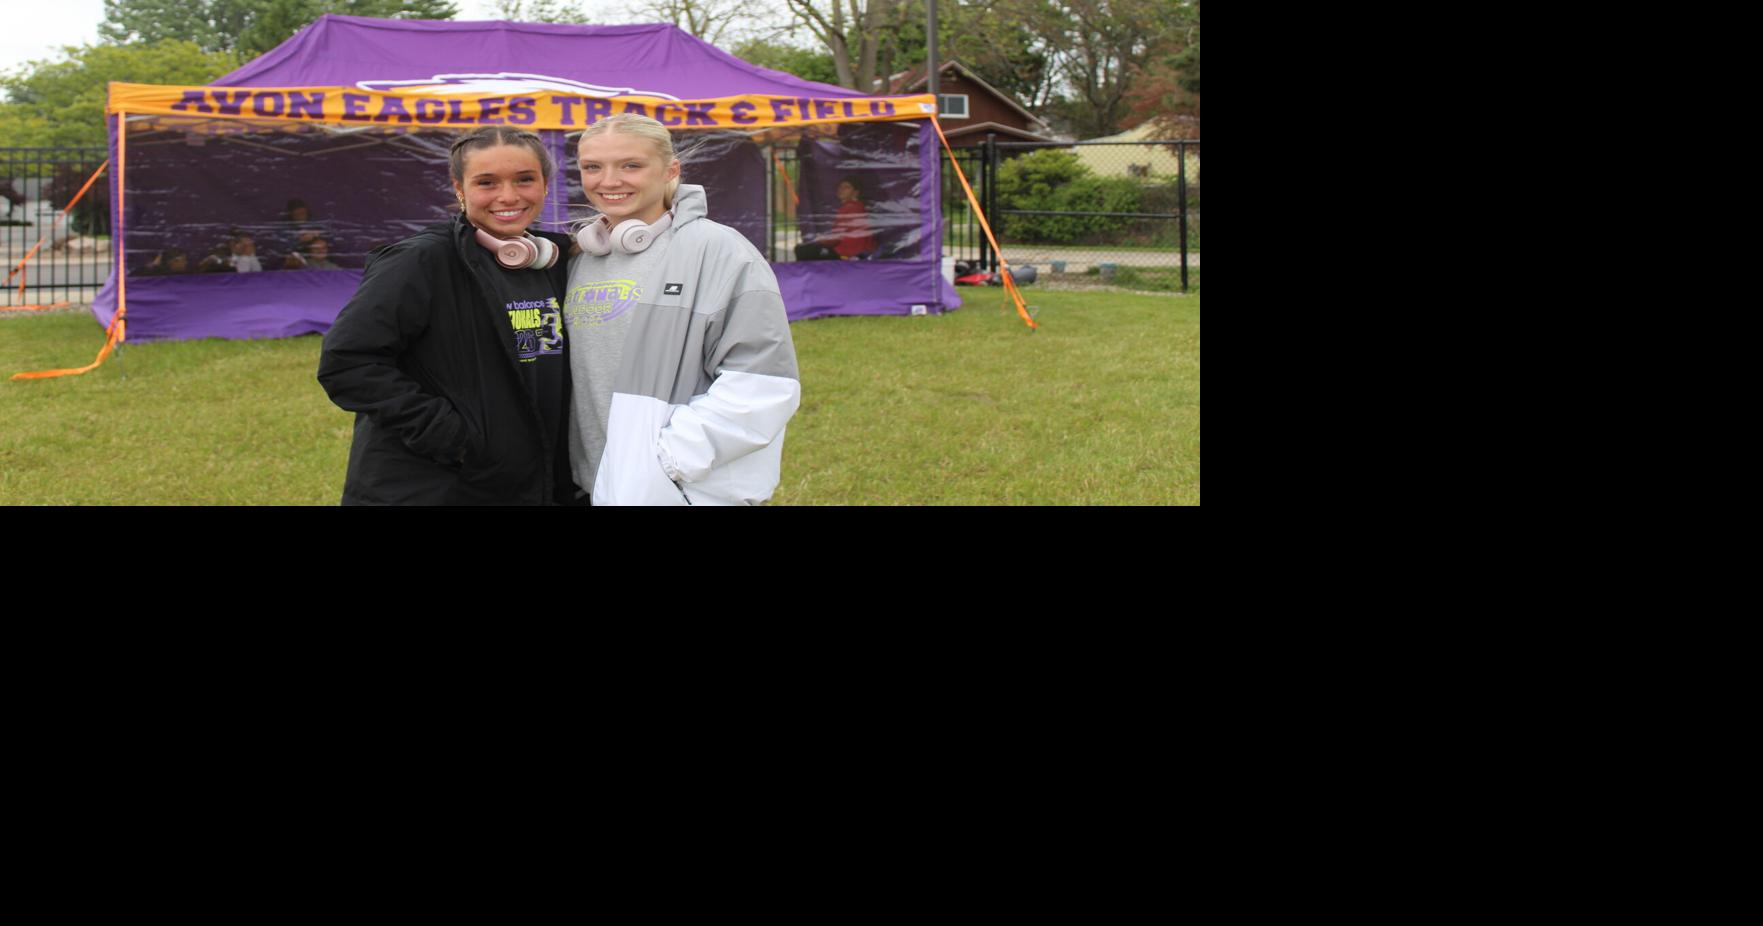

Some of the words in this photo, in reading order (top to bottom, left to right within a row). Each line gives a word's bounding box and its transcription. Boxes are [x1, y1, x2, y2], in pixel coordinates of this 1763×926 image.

[171, 90, 325, 118] AVON
[342, 92, 536, 125] EAGLES
[551, 95, 719, 127] TRACK
[730, 102, 759, 125] &
[765, 97, 896, 122] FIELD
